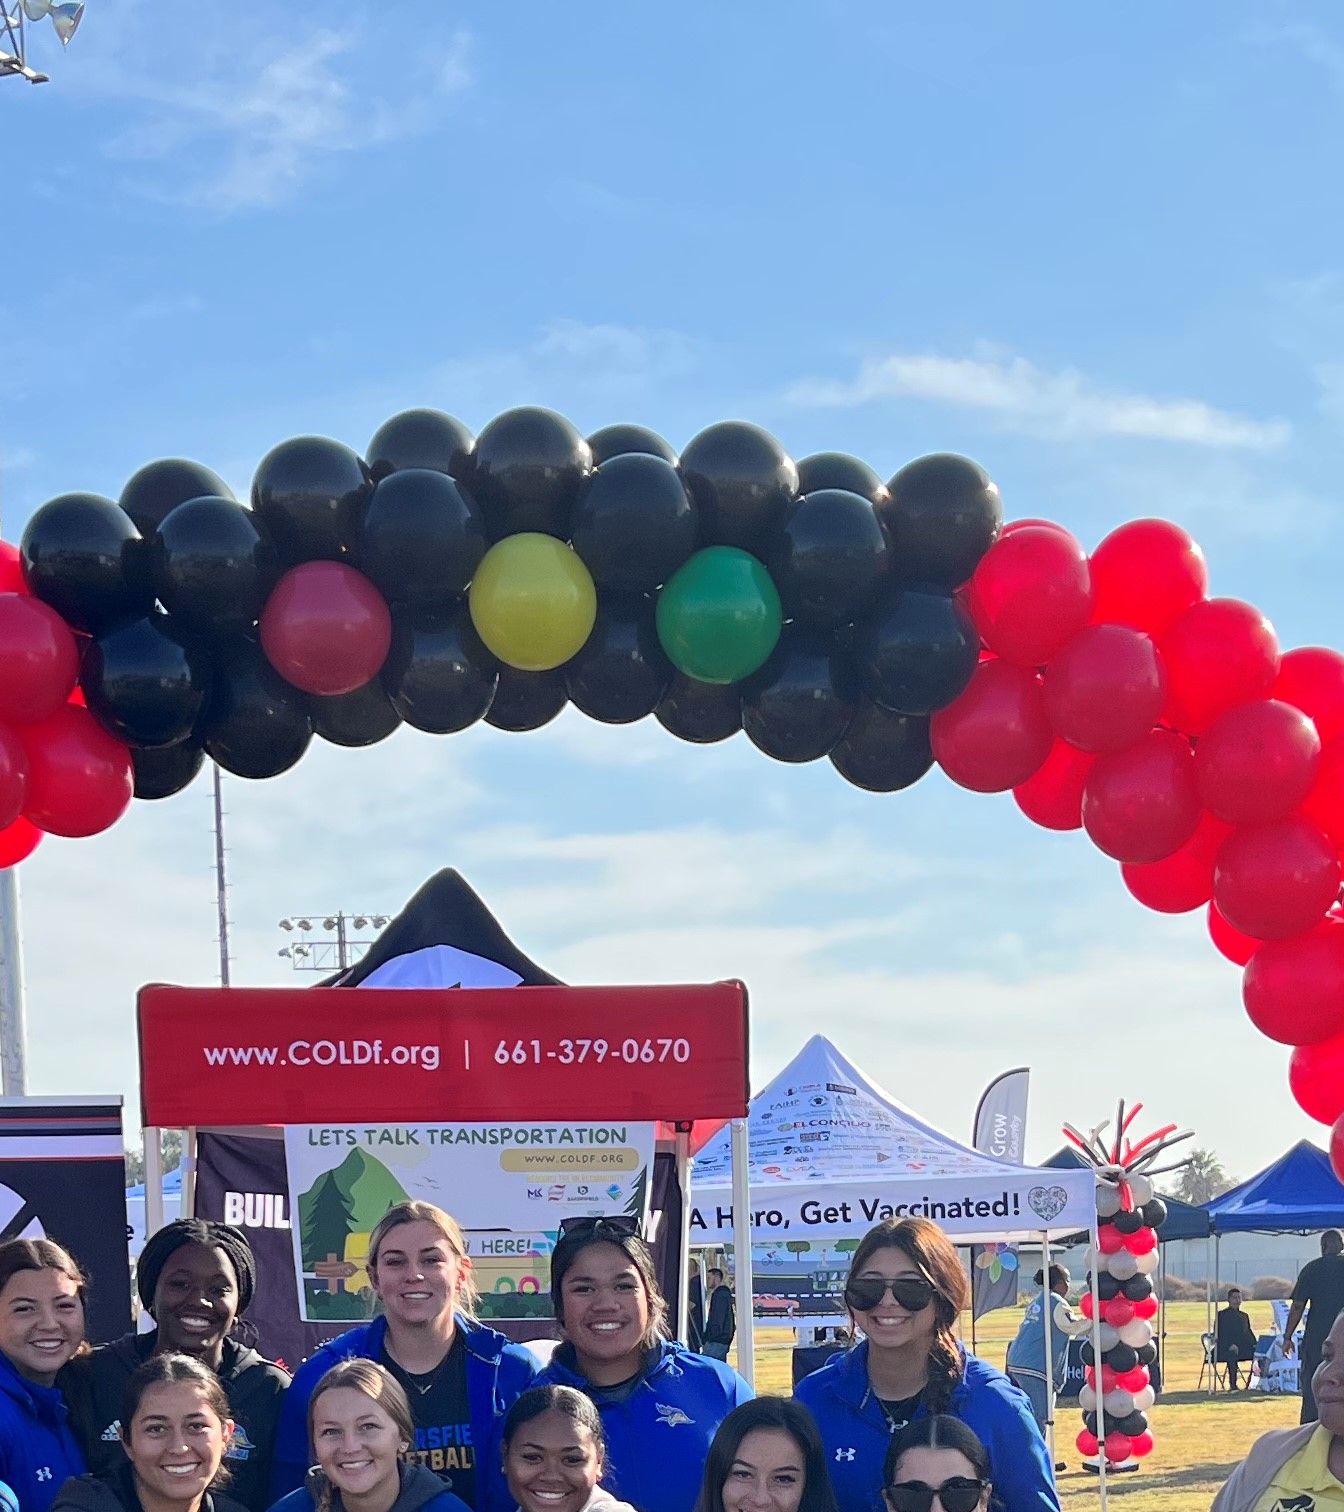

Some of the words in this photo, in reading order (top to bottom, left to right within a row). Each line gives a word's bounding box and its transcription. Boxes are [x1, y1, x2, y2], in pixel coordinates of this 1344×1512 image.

[203, 1039, 441, 1071] www.COLDf.org
[493, 1038, 691, 1065] 661-379-0670
[308, 1128, 358, 1146] LETS
[364, 1128, 419, 1146] TALK
[426, 1127, 627, 1145] TRANSPORTATION
[990, 1113, 1008, 1158] Grow
[524, 1154, 625, 1165] WWW.COLDF.ORG
[224, 1191, 293, 1229] BUIL
[690, 1210, 708, 1231] A
[799, 1200, 853, 1224] Get
[858, 1192, 1021, 1223] Vaccinated!
[481, 1238, 532, 1255] HERE!
